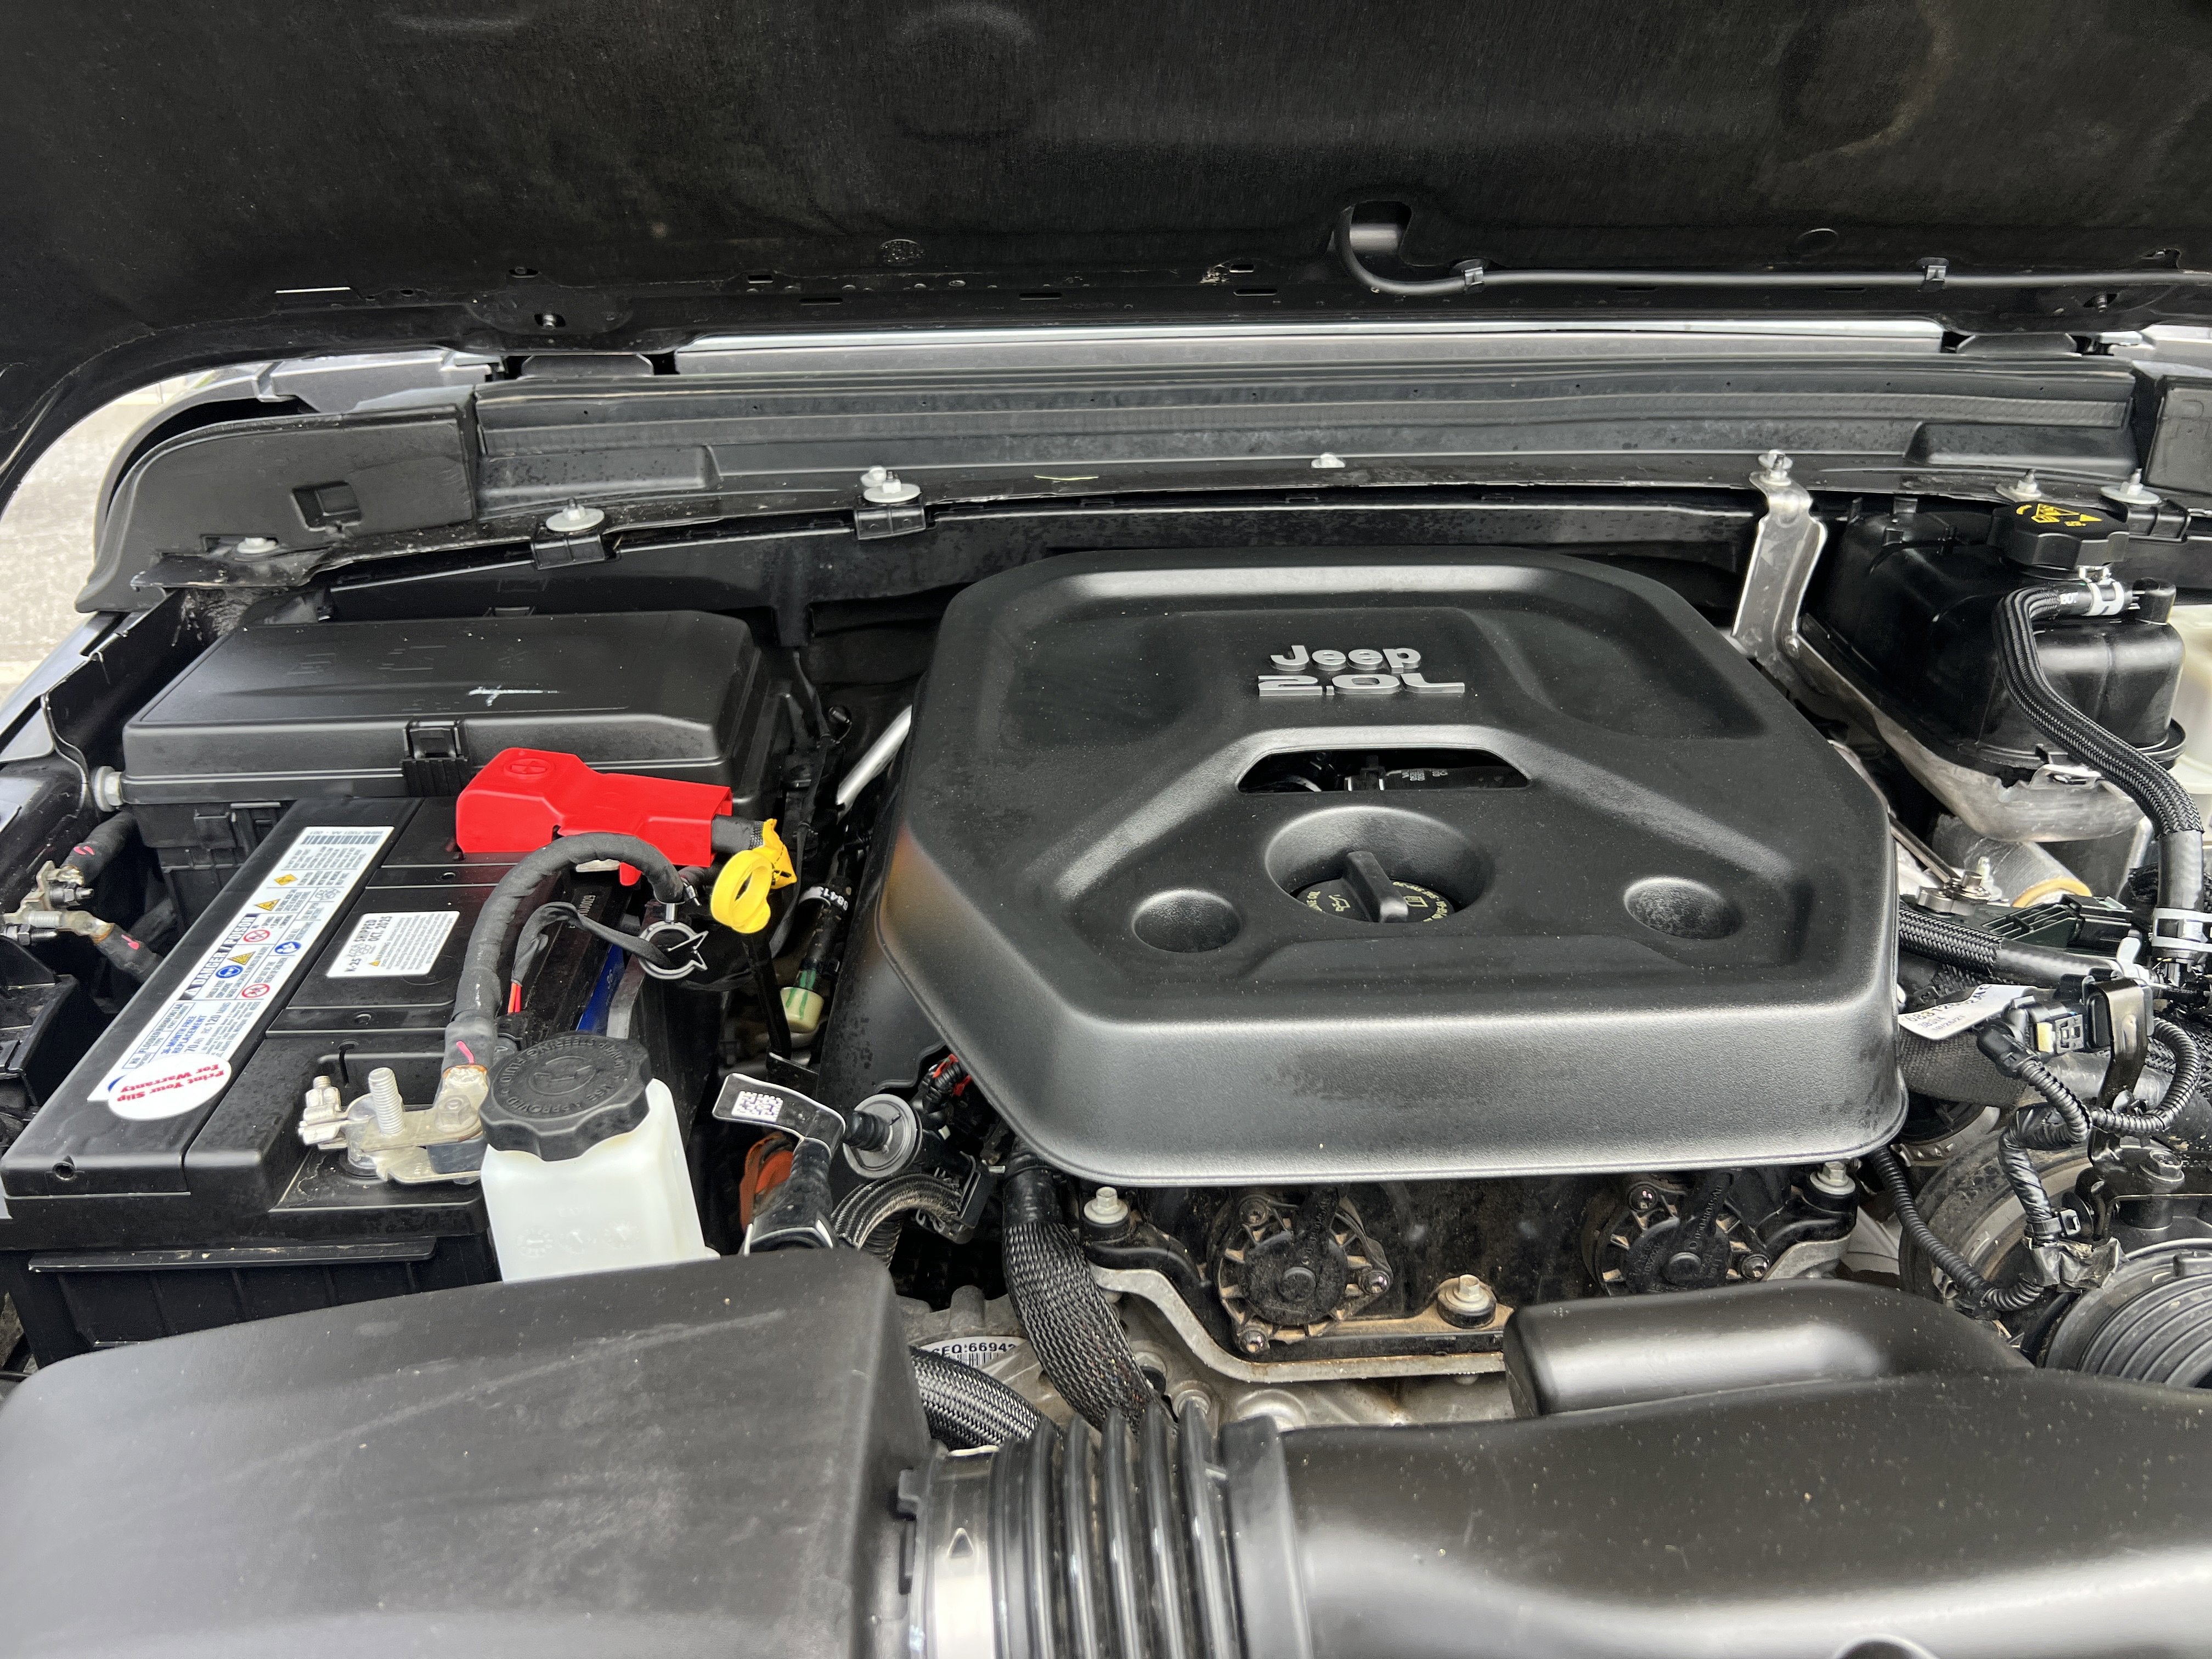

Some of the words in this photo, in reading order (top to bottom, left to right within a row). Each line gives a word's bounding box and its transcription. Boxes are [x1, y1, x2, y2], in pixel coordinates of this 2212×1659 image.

[1270, 645, 1421, 674] Jeep
[1257, 673, 1465, 697] 2.0L
[354, 919, 377, 942] SHIPPED
[375, 916, 392, 929] 2025
[368, 930, 384, 941] OCT.
[192, 952, 227, 985] DANGER
[224, 917, 255, 944] POISON
[205, 1015, 221, 1026] 120
[138, 1031, 161, 1053] FLOODED
[161, 1028, 186, 1054] 36-MONTH
[182, 1016, 196, 1028] FREE
[172, 1015, 206, 1053] REPLACEMENT
[527, 1036, 597, 1059] STEERING
[187, 1070, 224, 1084] Print
[196, 1064, 219, 1074] For
[500, 1057, 527, 1083] FLUID
[121, 1072, 192, 1092] Warranty
[149, 1082, 184, 1093] Your
[116, 1091, 145, 1102] Slip
[507, 1097, 582, 1115] APPROVED
